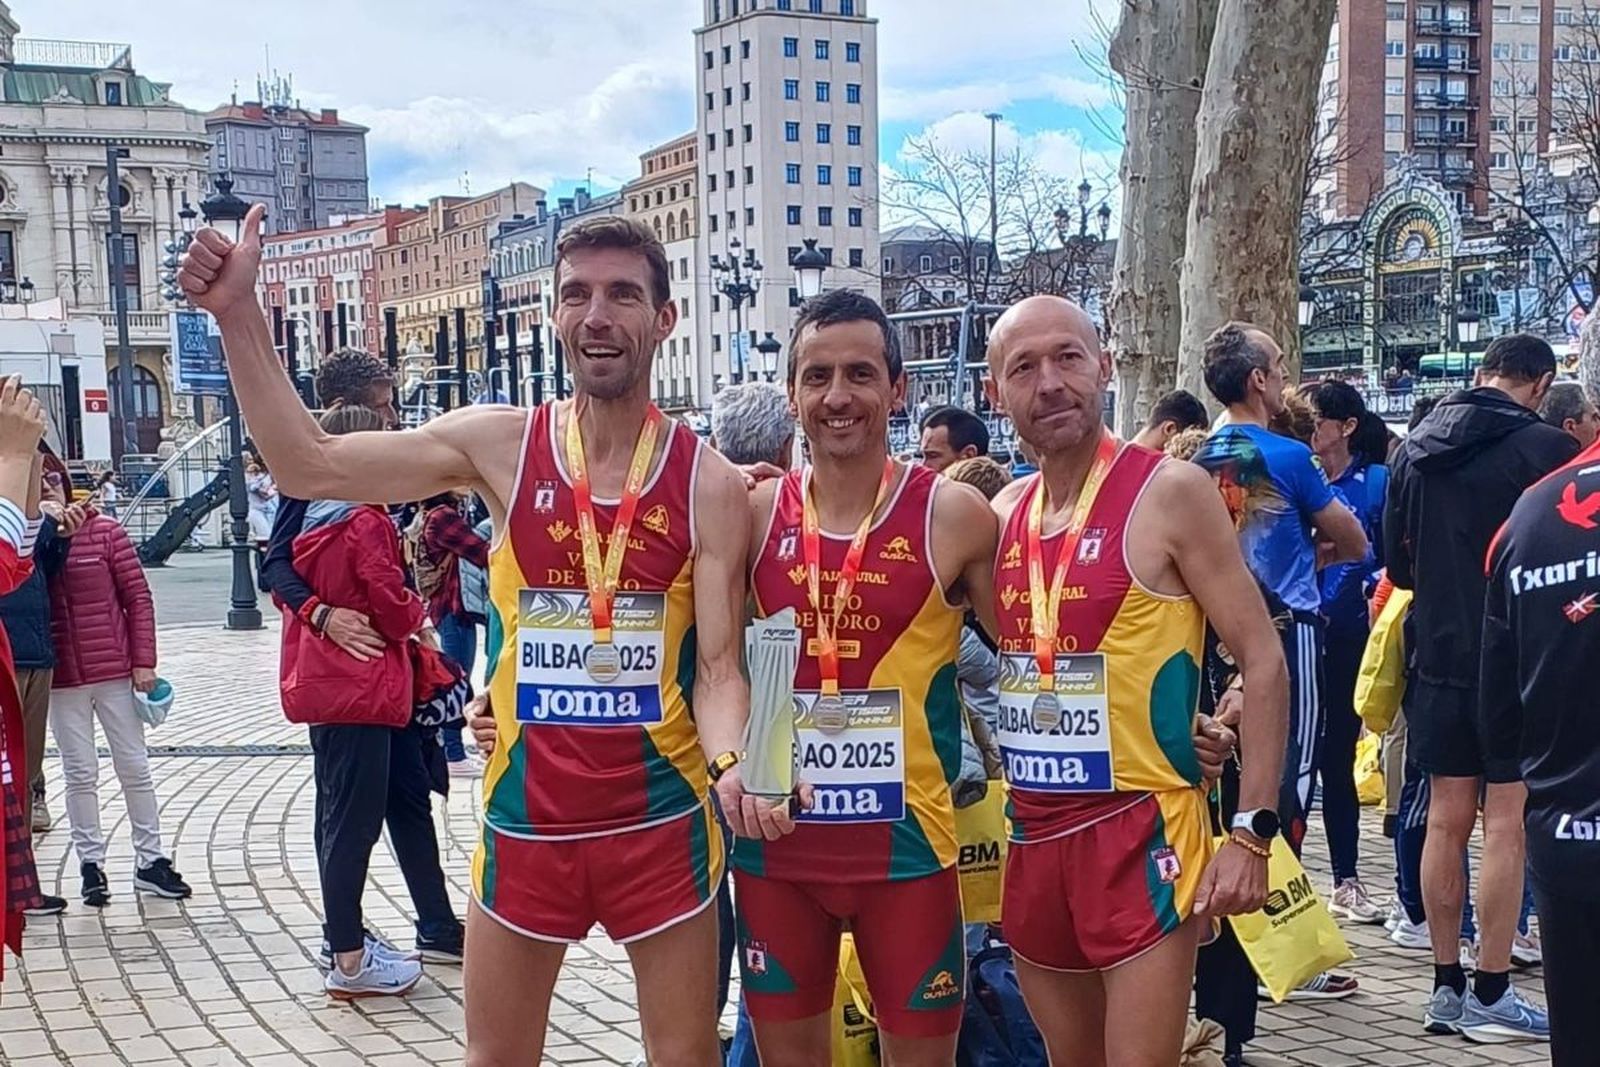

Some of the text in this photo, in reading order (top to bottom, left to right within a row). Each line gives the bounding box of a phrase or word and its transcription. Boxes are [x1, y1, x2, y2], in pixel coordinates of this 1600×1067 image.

[547, 569, 576, 585] DE
[1510, 551, 1600, 596] Txari
[614, 645, 656, 671] 025
[841, 741, 896, 769] 2025
[958, 841, 1000, 867] BM
[1287, 873, 1313, 904] BM
